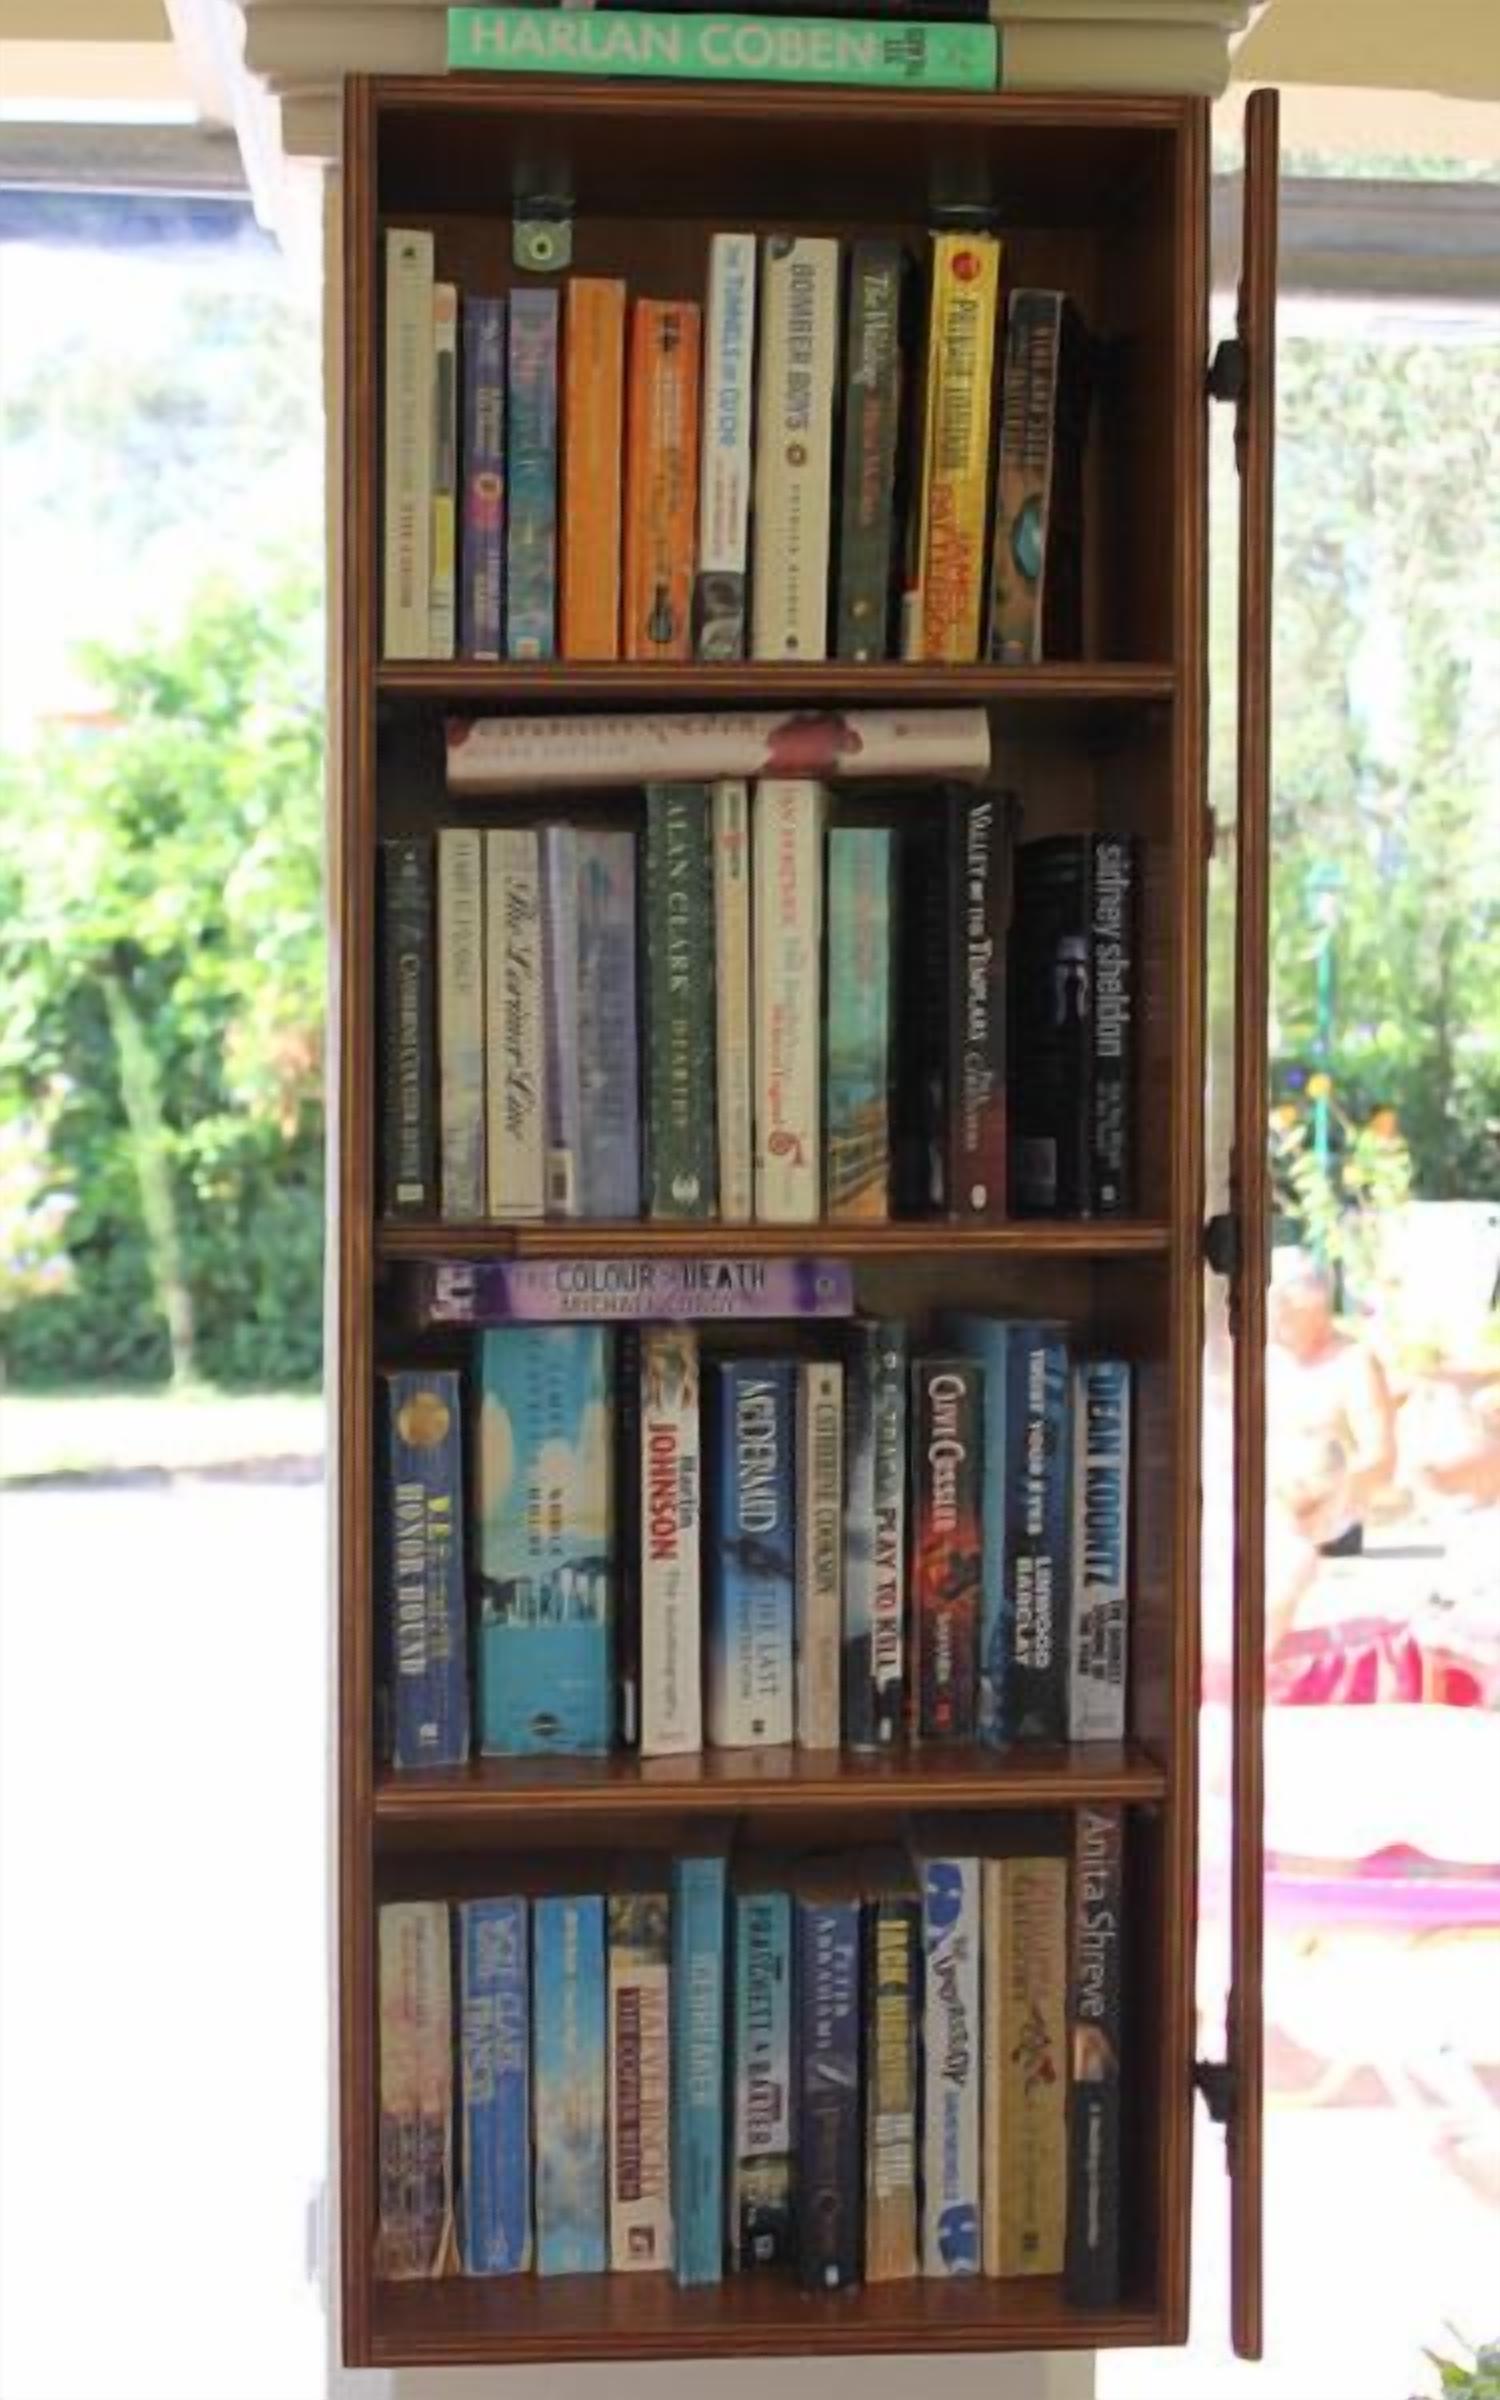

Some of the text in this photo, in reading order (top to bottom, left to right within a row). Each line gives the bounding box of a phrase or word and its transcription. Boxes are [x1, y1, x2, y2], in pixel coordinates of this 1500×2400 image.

[471, 16, 681, 63] HARLAN
[698, 23, 875, 70] COBEN
[789, 263, 814, 365] BOMBER
[667, 800, 690, 878] ALAN
[1093, 844, 1131, 940] sidney
[667, 891, 690, 993] CLARK
[1094, 943, 1130, 1056] sheldon
[556, 1263, 655, 1293] COLOUR
[683, 1261, 767, 1292] DEATH
[928, 1374, 967, 1437] CLIVE
[648, 1422, 678, 1560] JOHNSON
[928, 1439, 967, 1534] CUSSLER
[1083, 1373, 1123, 1589] DEAN KOONTZ
[396, 1482, 428, 1675] HONOR BOUND
[1016, 1556, 1035, 1666] BARCLAY
[757, 1641, 780, 1697] LAST
[877, 1919, 910, 1987] JACK
[1077, 1814, 1116, 2018] Anita Shreve
